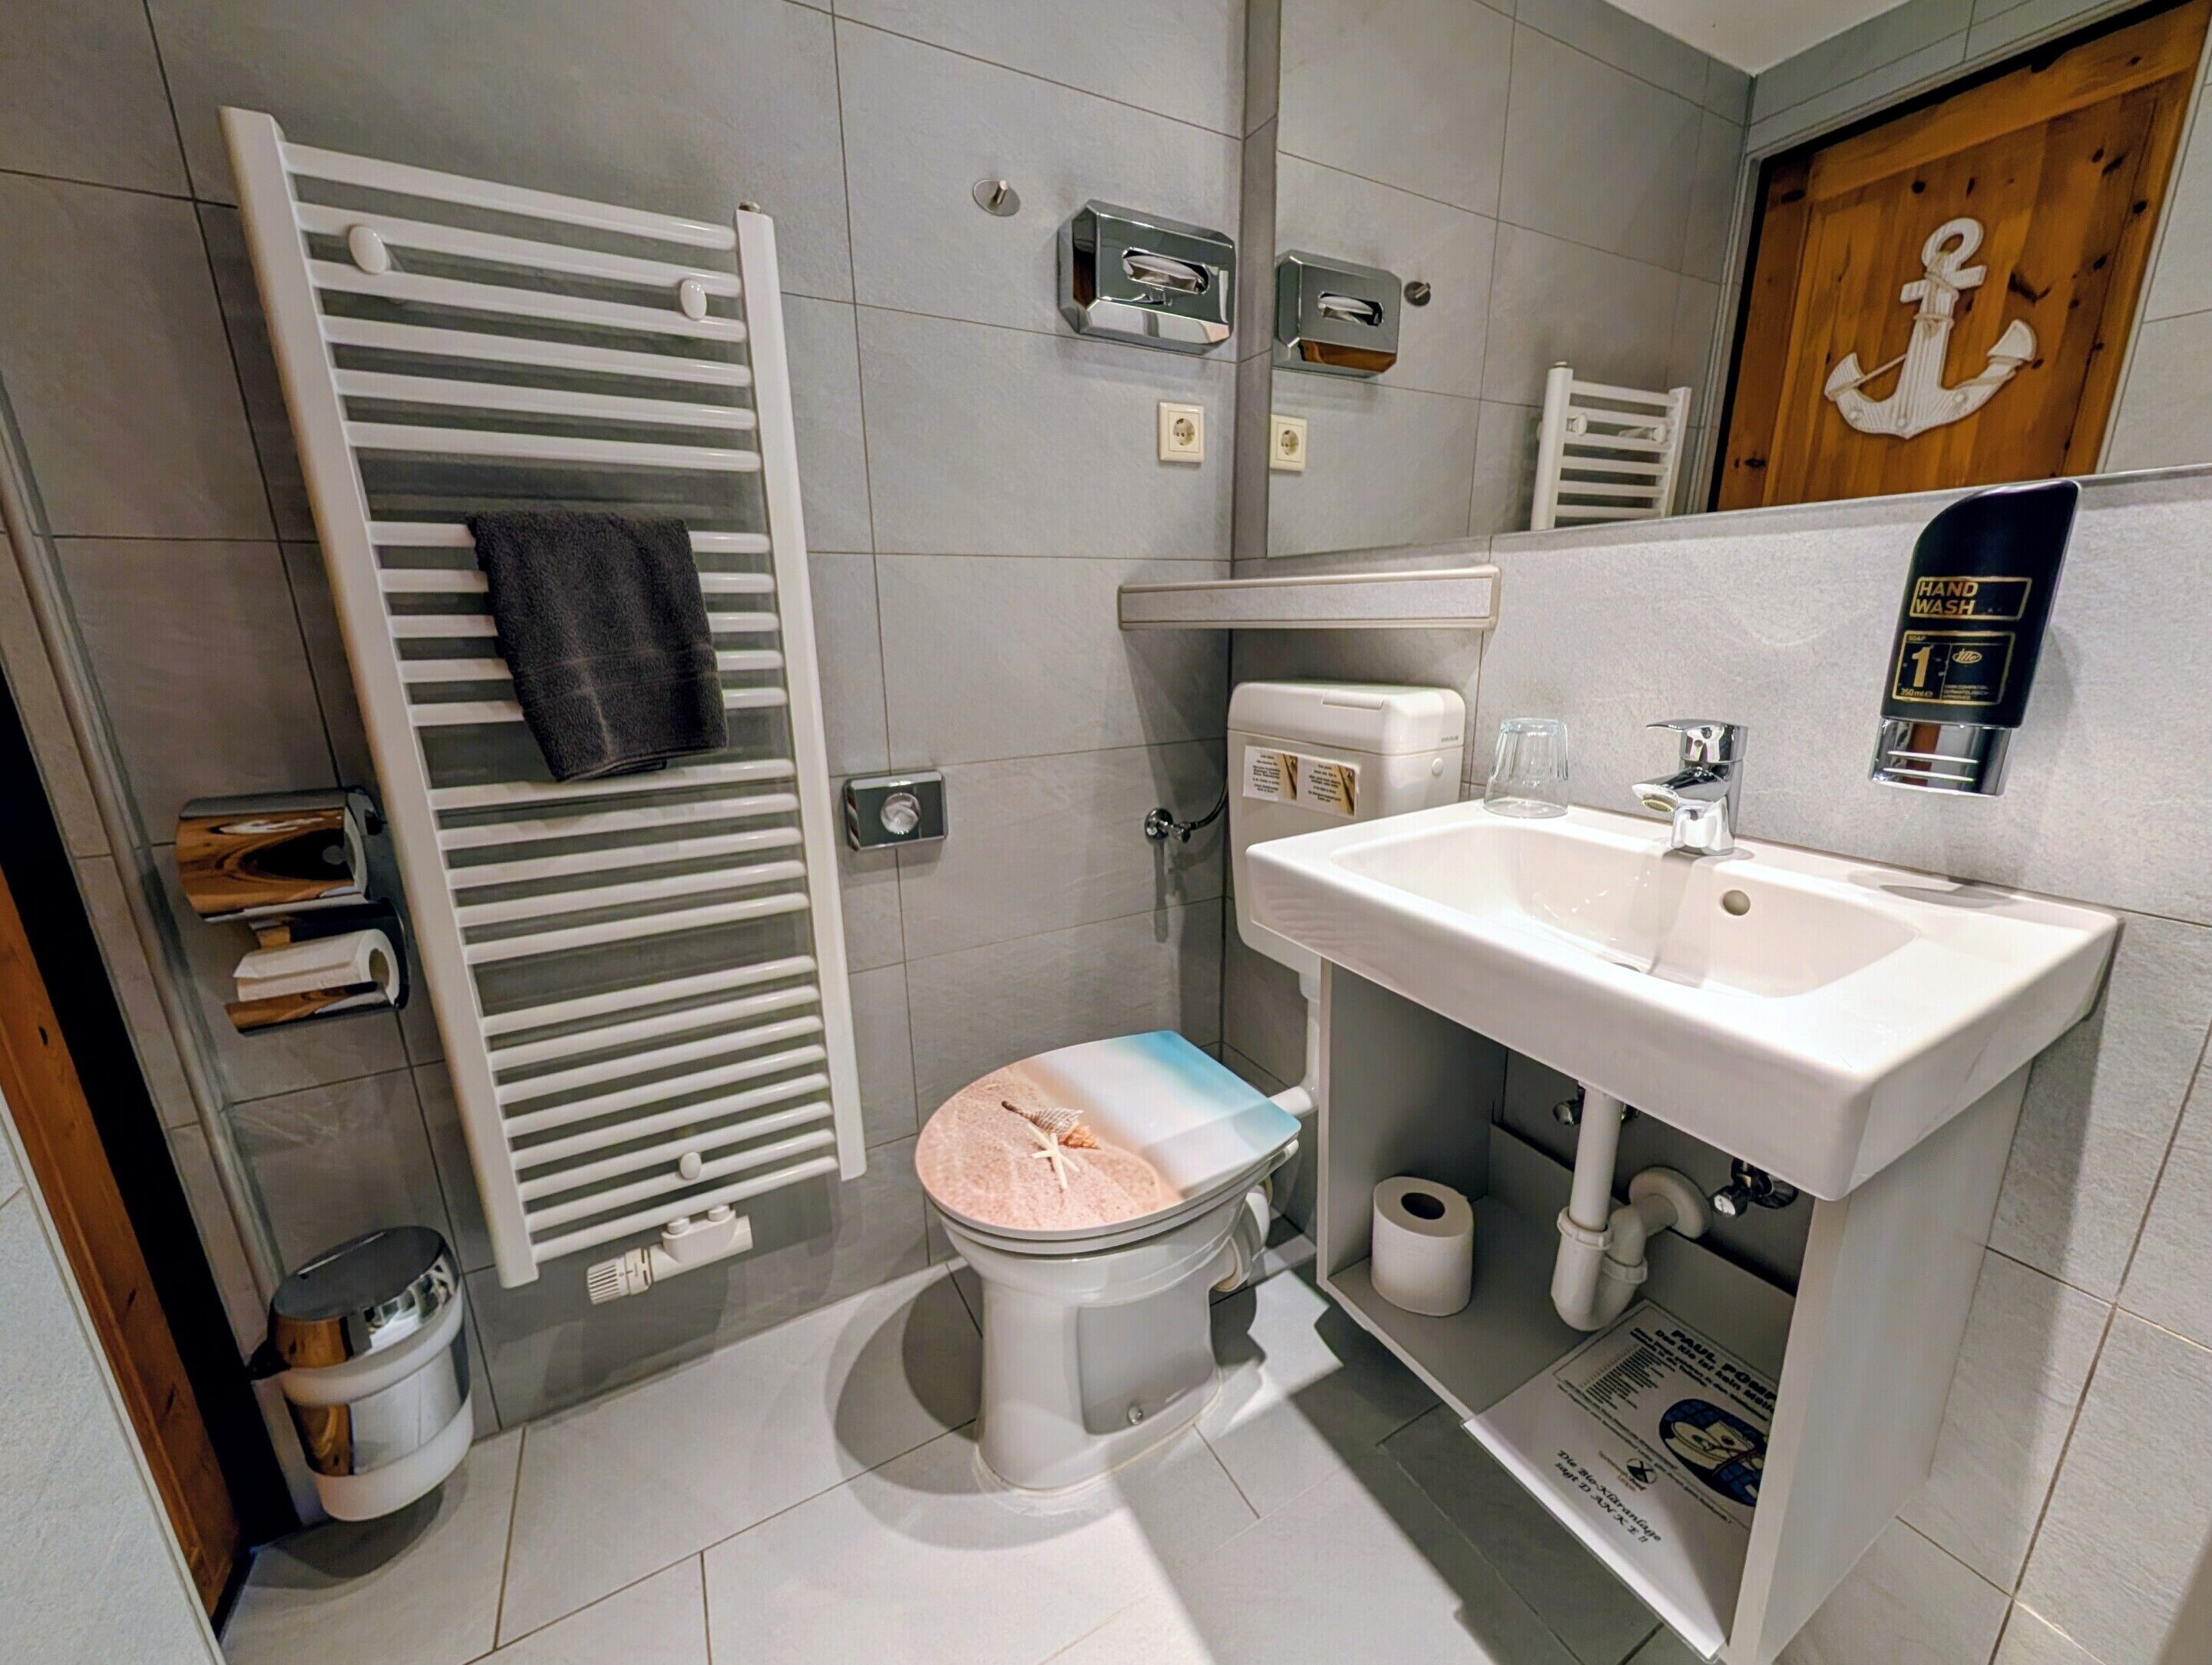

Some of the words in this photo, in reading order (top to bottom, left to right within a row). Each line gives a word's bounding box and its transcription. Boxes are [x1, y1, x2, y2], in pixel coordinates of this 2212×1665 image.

[1919, 581, 1979, 597] HAND
[1916, 599, 1976, 615] WASH
[1912, 646, 1932, 688] 1
[1671, 1330, 1716, 1363] PAUL
[1678, 1345, 1696, 1359] Klo
[1698, 1359, 1714, 1371] ist
[1715, 1370, 1741, 1390] kein
[1556, 1462, 1579, 1482] sagt
[1558, 1449, 1577, 1467] Die
[1578, 1468, 1661, 1541] Bio-Kläranlage
